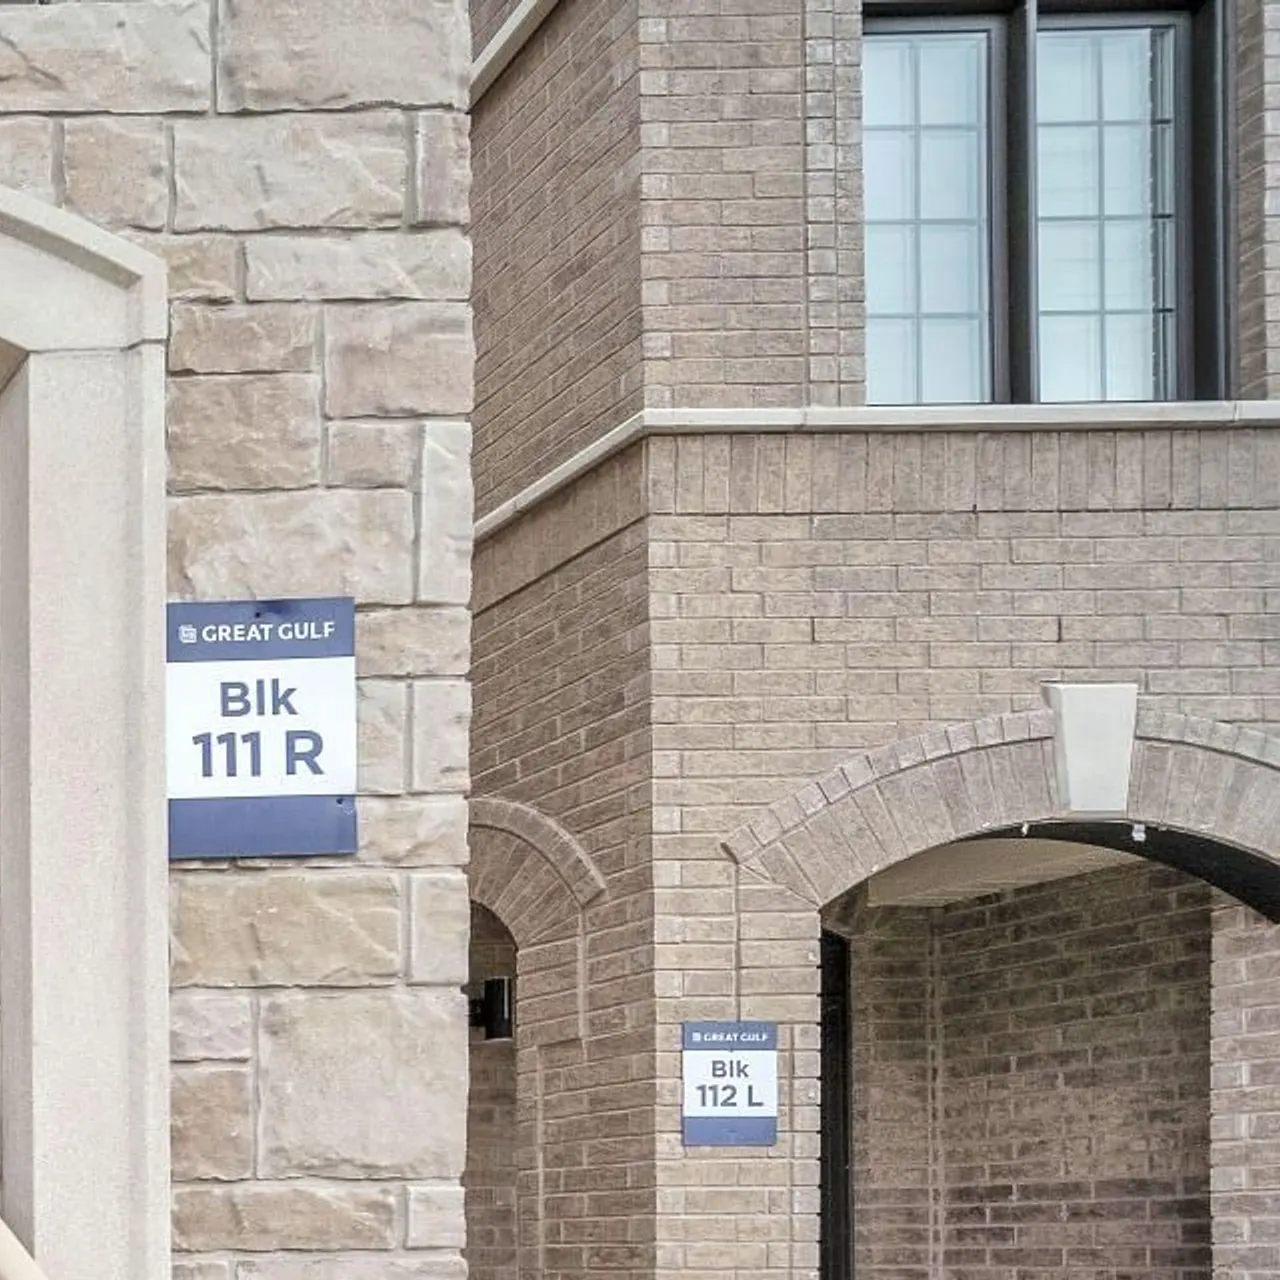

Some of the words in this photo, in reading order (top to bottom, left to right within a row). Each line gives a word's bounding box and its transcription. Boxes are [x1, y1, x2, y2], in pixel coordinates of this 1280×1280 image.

[202, 624, 273, 642] GREAT
[278, 621, 335, 640] GULF
[220, 678, 298, 717] Blk
[192, 731, 261, 777] 111
[285, 730, 324, 775] R
[703, 1032, 739, 1041] GREAT
[740, 1032, 768, 1041] GULF
[712, 1060, 749, 1078] Blk
[696, 1084, 737, 1107] 112
[748, 1085, 764, 1107] L
